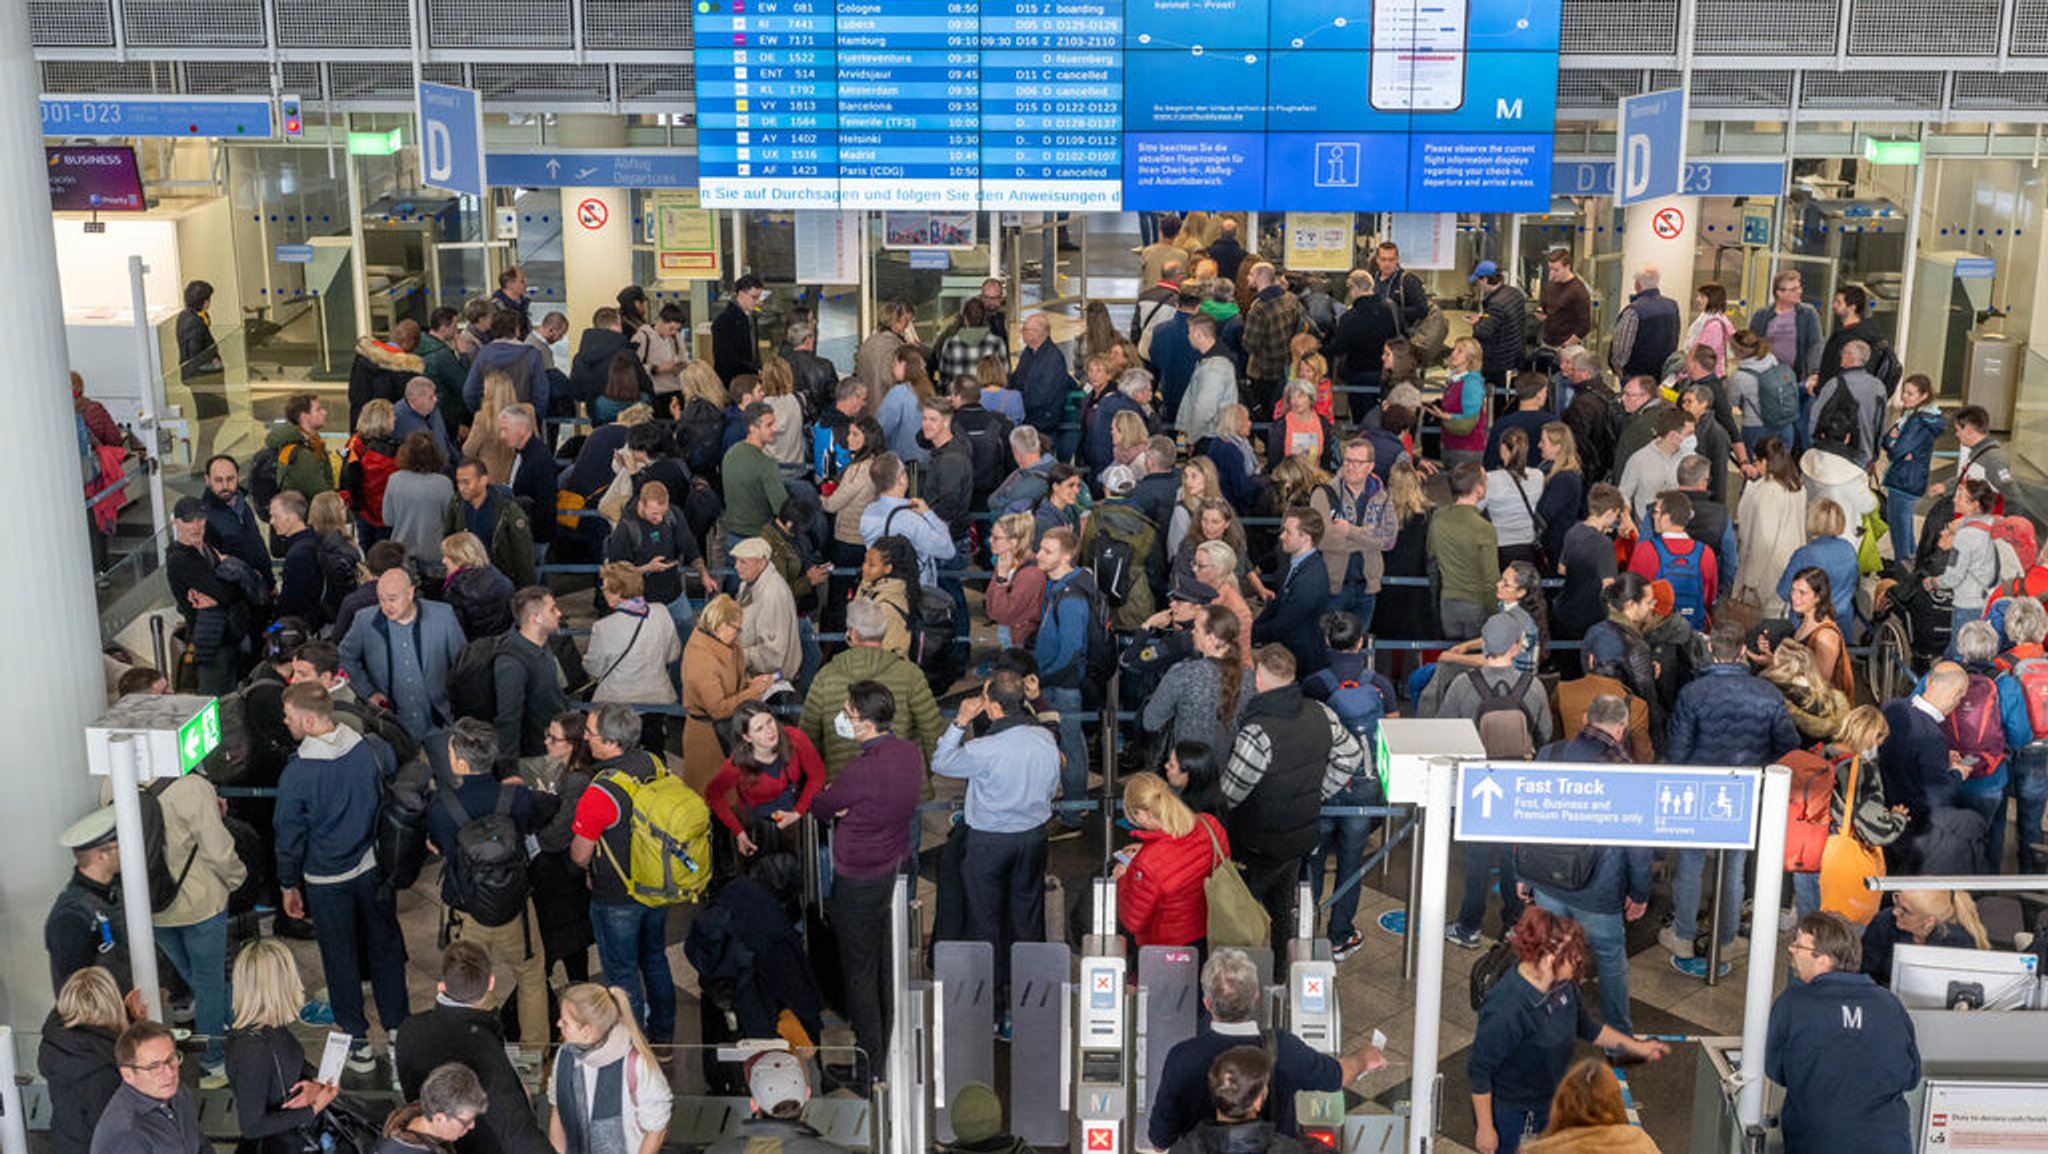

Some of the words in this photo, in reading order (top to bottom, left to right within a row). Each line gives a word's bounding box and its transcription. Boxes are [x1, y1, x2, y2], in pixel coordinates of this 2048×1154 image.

[758, 3, 777, 14] EW
[837, 4, 881, 15] Cologne
[1016, 4, 1038, 14] D15
[1056, 4, 1104, 16] boarding
[759, 35, 778, 46] EW
[789, 35, 814, 46] 7171
[838, 36, 886, 47] Hamburg
[948, 36, 979, 46] 09:10
[760, 68, 784, 79] ENT
[795, 68, 816, 79] 514
[838, 69, 891, 82] Arvidsjaur
[948, 70, 979, 80] 09:45
[1016, 70, 1036, 80] D11
[1056, 70, 1108, 80] cancelled
[838, 85, 898, 96] Amsterdam
[1056, 86, 1108, 96] cancelled
[760, 101, 777, 111] VY
[838, 102, 892, 112] Barcelona
[1496, 98, 1522, 120] M
[840, 117, 883, 128] Tenerife
[886, 118, 916, 128] (TFS)
[762, 134, 778, 144] AY
[791, 134, 816, 144] 1402
[839, 134, 881, 144] Helsinki
[949, 135, 979, 145] 10:30
[427, 119, 451, 181] D
[1138, 142, 1157, 152] Bitte
[1160, 142, 1198, 152] beachten
[1200, 142, 1212, 152] Sie
[1215, 142, 1228, 152] die
[1424, 144, 1452, 153] Please
[1454, 144, 1487, 153] observe
[1489, 144, 1502, 153] the
[1504, 144, 1535, 153] current
[64, 155, 122, 165] BUSINESS
[840, 150, 876, 160] Madrid
[1138, 155, 1175, 163] aktuellen
[1232, 155, 1244, 163] für
[1424, 156, 1445, 165] flight
[1446, 156, 1492, 164] information
[1494, 156, 1528, 165] displays
[614, 158, 651, 172] Abflug
[1138, 166, 1160, 174] Ihren
[1626, 134, 1651, 198] D
[614, 172, 676, 184] Departures
[840, 166, 868, 176] Paris
[870, 166, 904, 178] (CDG)
[1056, 167, 1108, 177] cancelled
[1424, 168, 1464, 176] regarding
[1466, 168, 1484, 176] your
[1578, 166, 1594, 190] D
[1424, 179, 1462, 188] departure
[716, 188, 739, 200] Sie
[744, 188, 766, 200] auf
[772, 188, 859, 202] Durchsagen
[864, 190, 892, 201] und
[896, 189, 941, 202] folgen
[946, 189, 970, 201] Sie
[974, 190, 1003, 202] den
[1008, 190, 1106, 204] Anweisungen
[1516, 777, 1552, 794] Fast
[1558, 778, 1605, 795] Track
[1544, 798, 1588, 810] Business
[1592, 800, 1610, 810] and
[1514, 810, 1560, 820] Premium
[1562, 811, 1619, 824] Passengers
[1622, 814, 1642, 825] only
[1842, 1006, 1862, 1029] M
[1090, 1093, 1110, 1112] M
[1311, 1098, 1330, 1117] M
